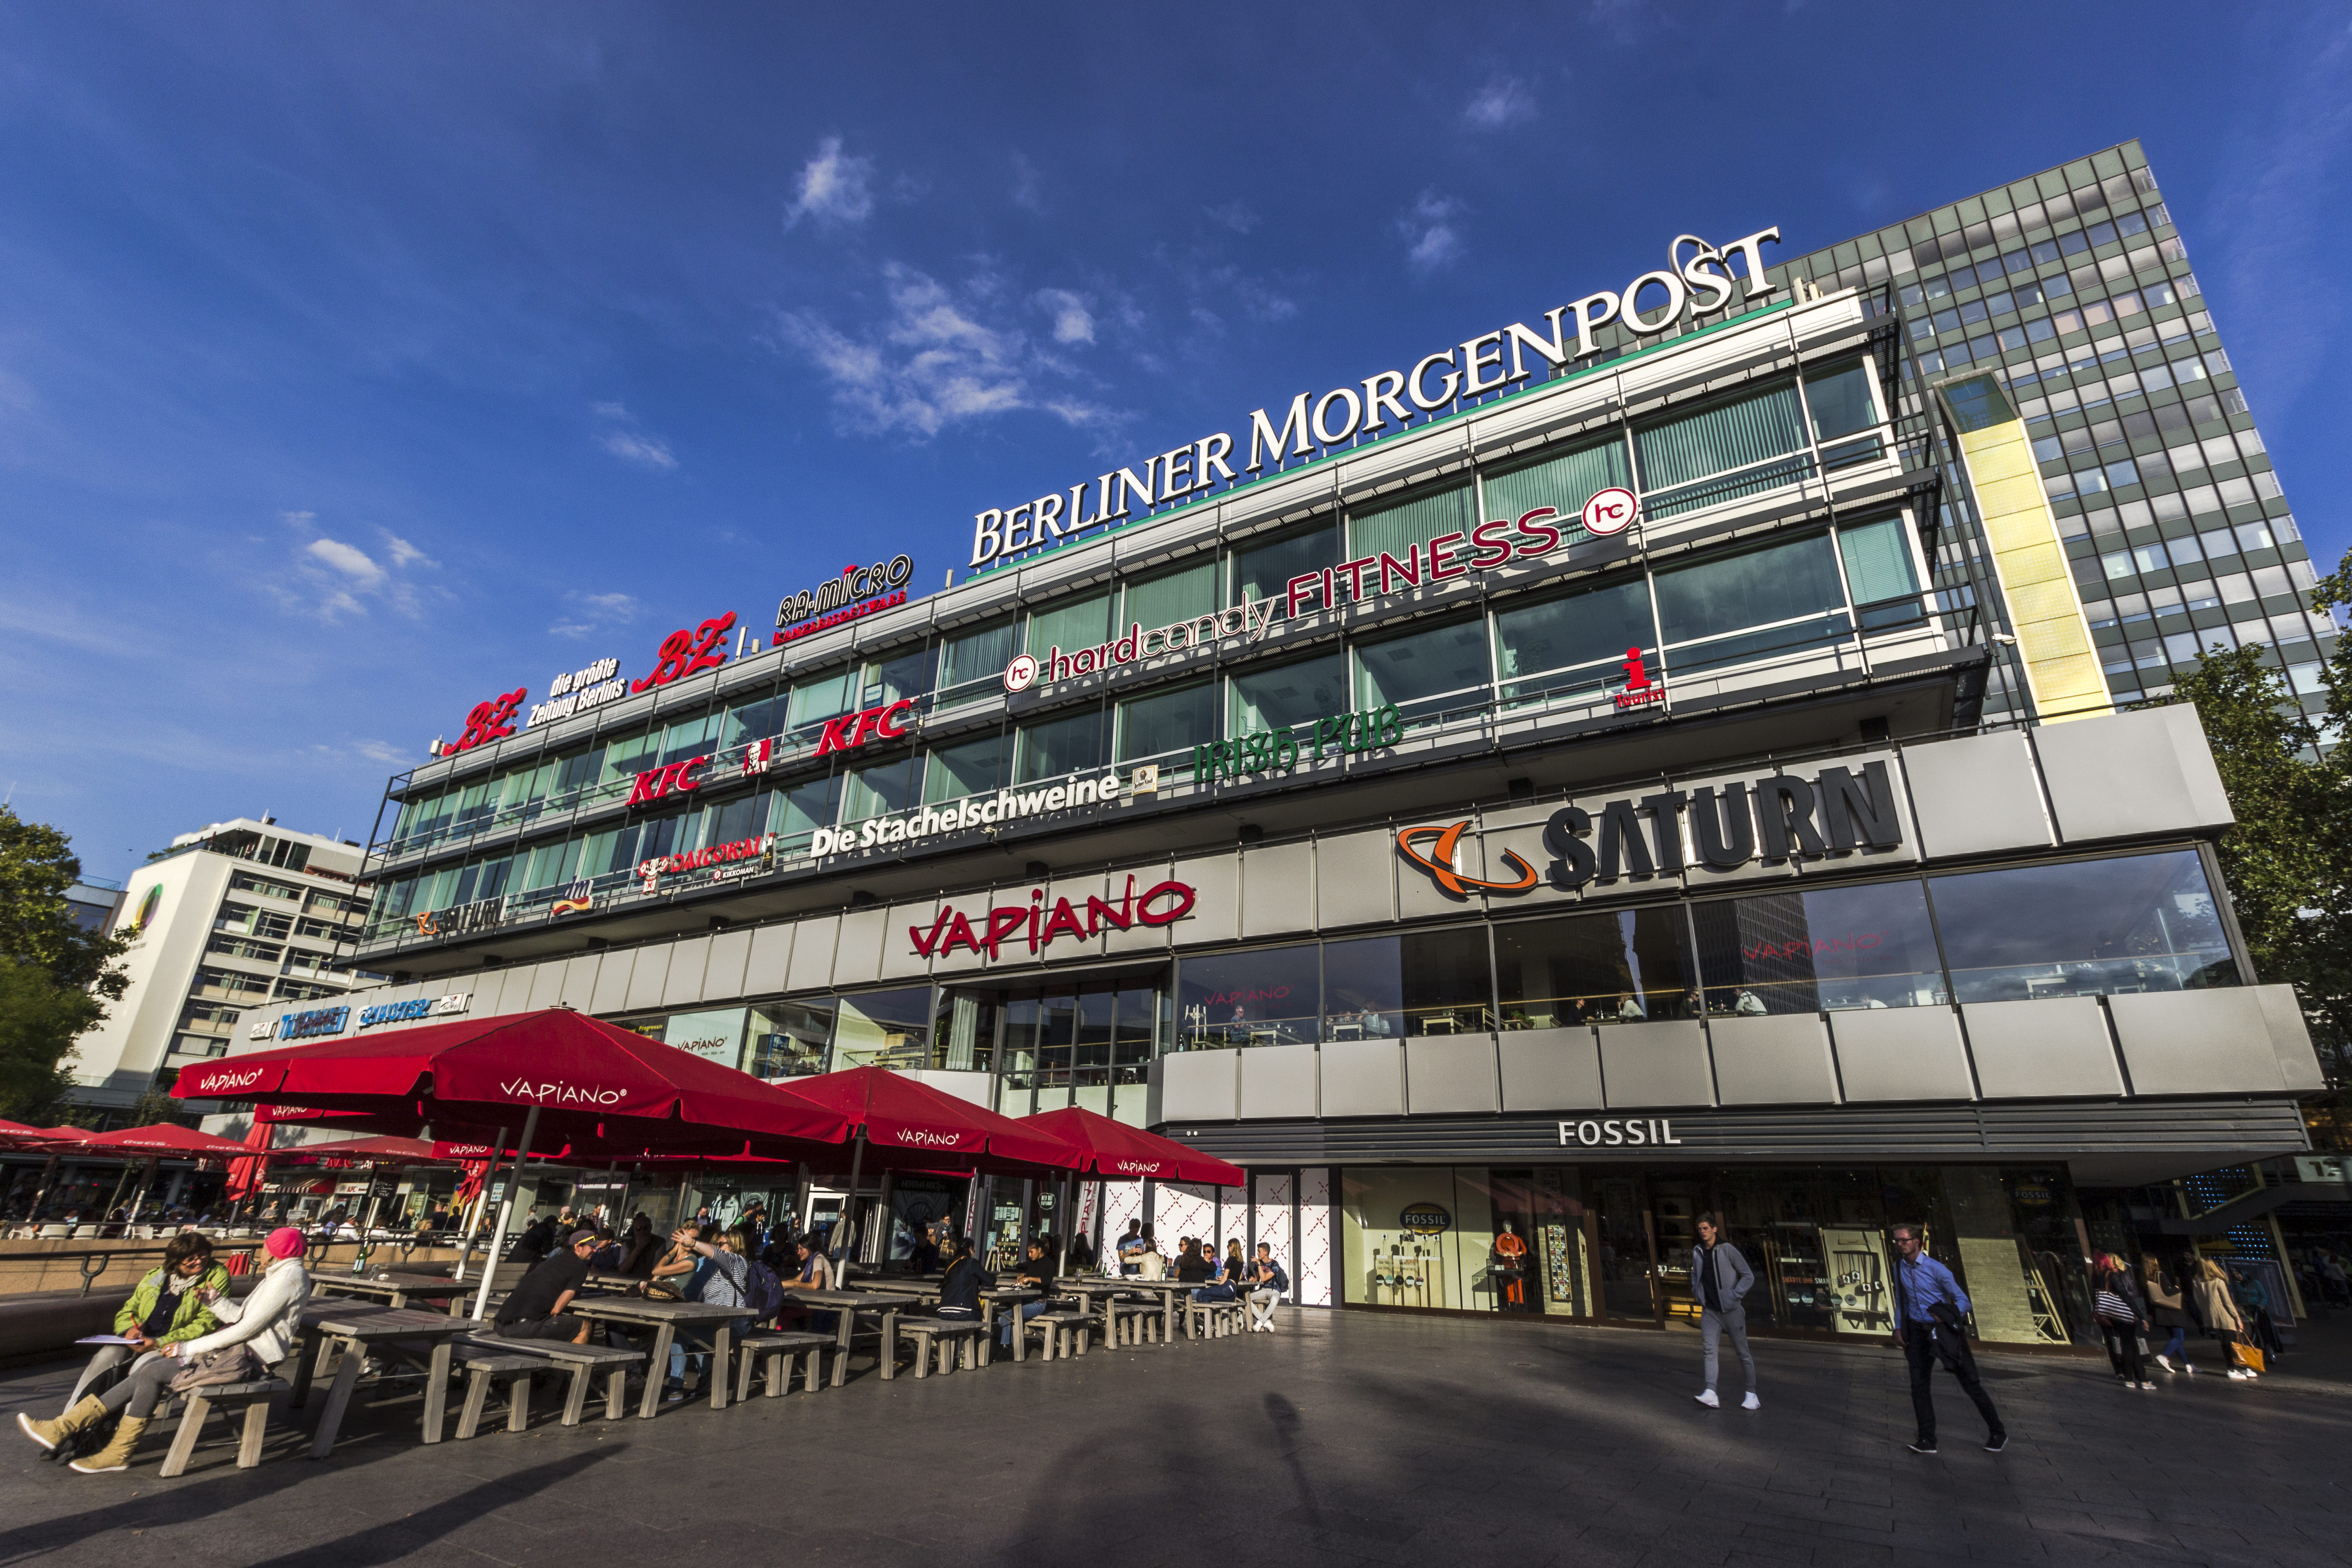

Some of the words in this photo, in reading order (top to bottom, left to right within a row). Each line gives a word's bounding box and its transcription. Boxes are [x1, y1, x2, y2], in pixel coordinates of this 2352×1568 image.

[969, 432, 1239, 568] BERLINER
[1245, 226, 1780, 474] MORGENPOST
[1287, 506, 1561, 619] FITNESS
[773, 591, 907, 645] KANZLEISOFTWARE
[550, 672, 573, 697] die
[573, 658, 620, 693] größte
[1615, 688, 1666, 707] Tourist
[526, 694, 578, 728] Zeitung
[577, 678, 628, 712] Berlins
[812, 698, 915, 757] KFC
[1194, 727, 1298, 784] IRISH
[1313, 704, 1405, 760] PUB
[625, 756, 708, 806] KFC
[811, 827, 857, 858] Die
[859, 775, 1120, 848] Stachelschweine
[1542, 760, 1903, 885] SATURN
[671, 836, 761, 872] DAITOKAI
[722, 866, 754, 878] KIKKOMAN
[562, 876, 594, 899] dm
[1559, 1119, 1681, 1146] FOSSIL
[1405, 1214, 1446, 1225] FOSSIL
